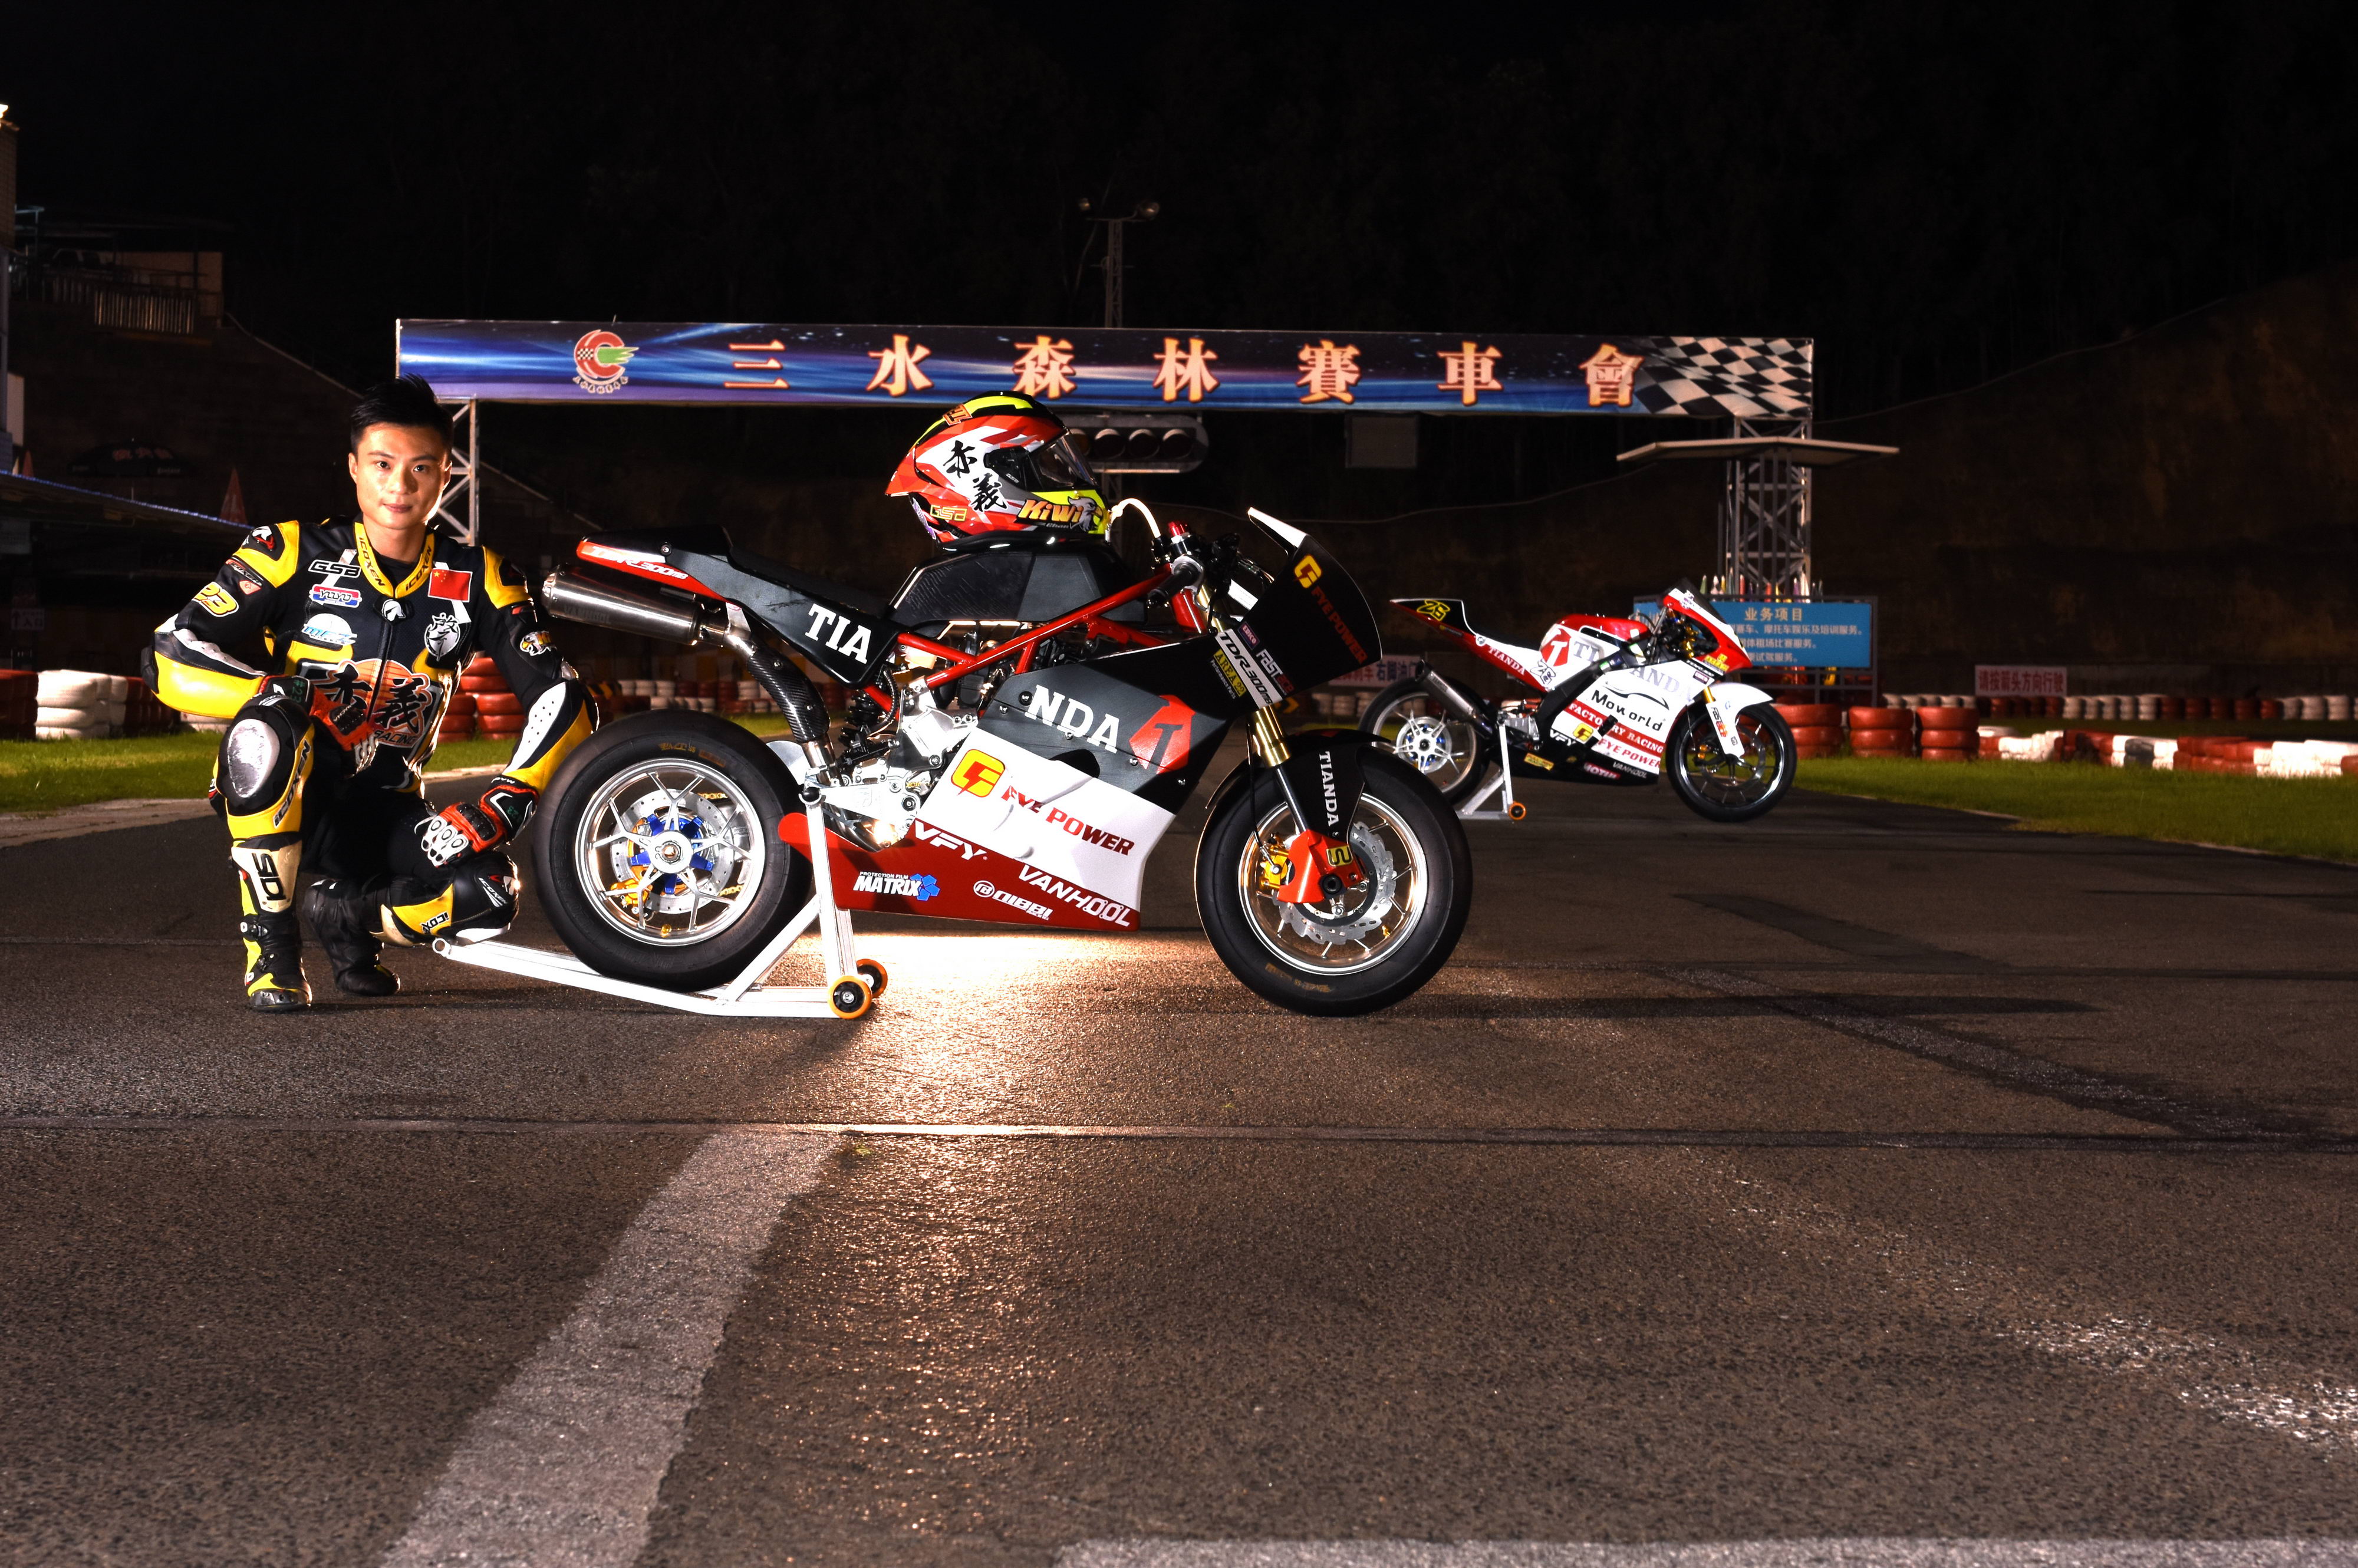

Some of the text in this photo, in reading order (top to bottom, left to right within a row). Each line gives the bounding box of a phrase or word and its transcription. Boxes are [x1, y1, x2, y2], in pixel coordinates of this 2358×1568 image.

[724, 333, 1646, 407] 三水森林賽車會
[1745, 608, 1803, 621] 业务项目
[805, 603, 872, 664] TIA
[1327, 613, 1368, 665] POWER
[1215, 654, 1237, 684] AREA
[1488, 646, 1526, 676] TIANDA
[1979, 670, 2063, 692] 请按箭头方向行驶
[1025, 684, 1119, 753] NDA
[373, 730, 416, 745] RACING
[1598, 739, 1661, 768] FYE POWER
[1627, 732, 1664, 754] RACING
[1319, 751, 1340, 826] TIANDA
[914, 819, 988, 861] VFY
[1046, 807, 1135, 856] POWER
[853, 875, 923, 897] MATRIX
[1018, 864, 1137, 927] VANHOOL
